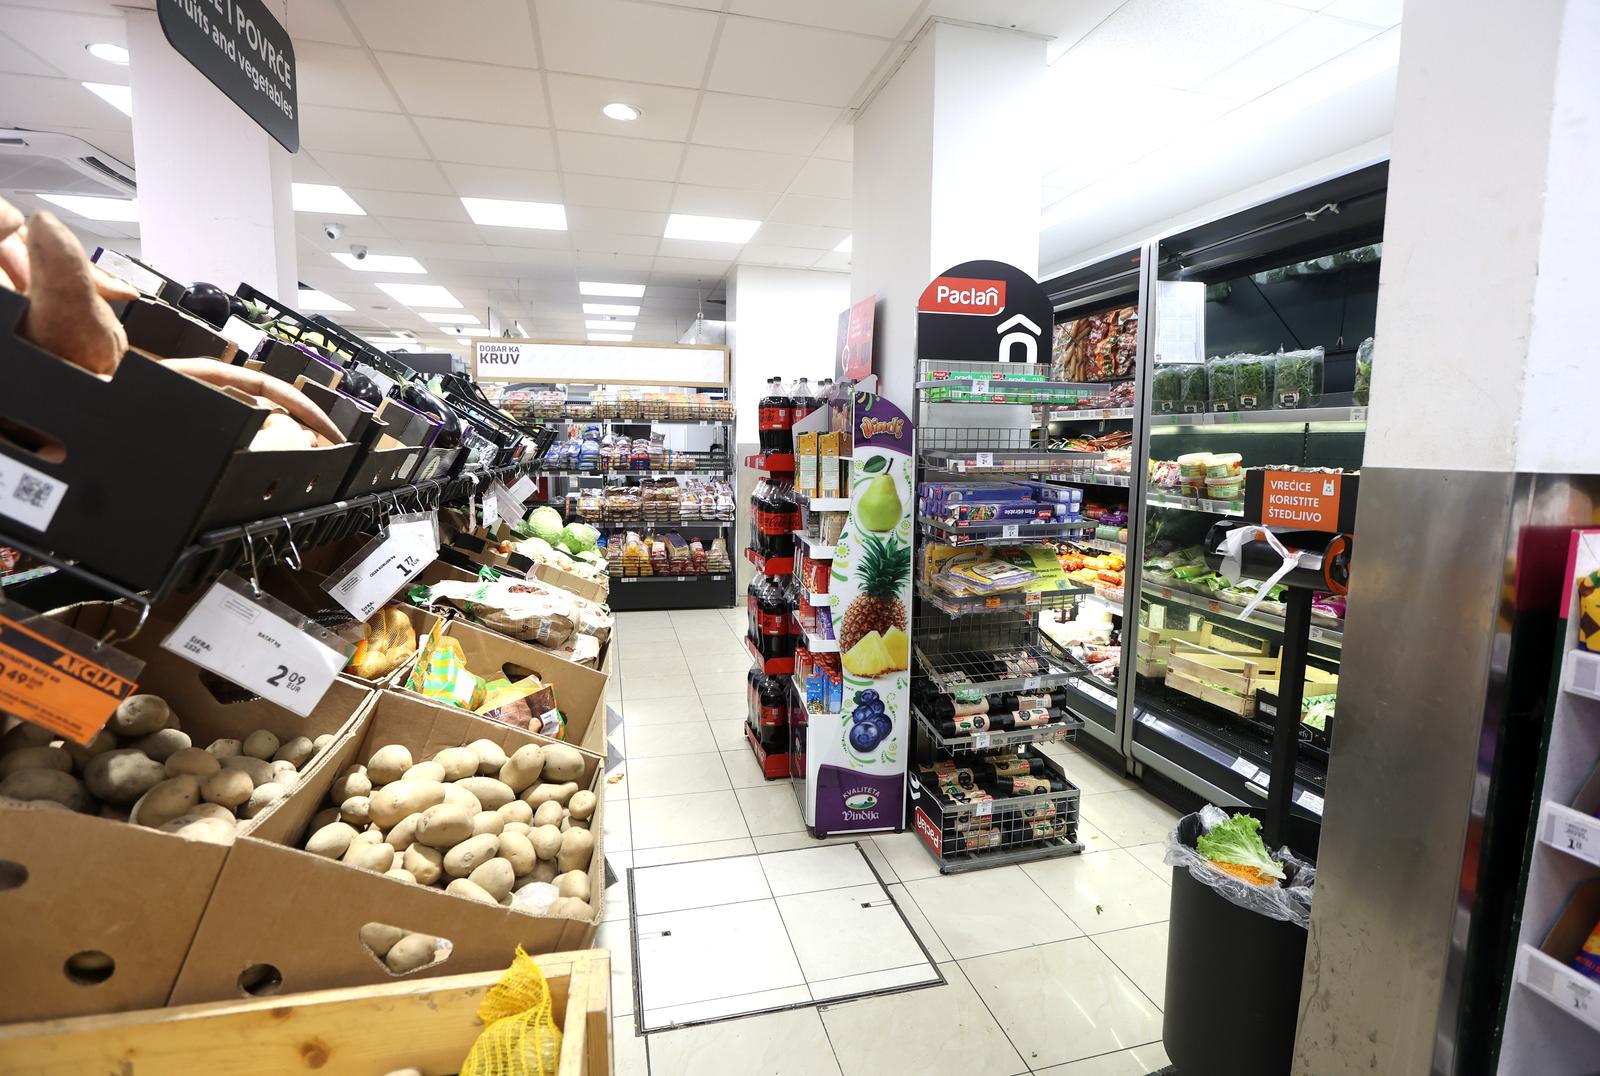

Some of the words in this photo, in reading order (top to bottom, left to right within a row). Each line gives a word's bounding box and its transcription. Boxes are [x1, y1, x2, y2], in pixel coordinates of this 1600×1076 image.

[236, 4, 292, 90] POVRĆE
[174, 0, 209, 35] uits
[212, 24, 236, 62] and
[238, 51, 293, 120] vegetables
[937, 285, 999, 306] Paclan
[480, 353, 520, 364] KRUV
[860, 416, 904, 439] Vindi
[1271, 479, 1311, 492] VREĆICE
[1269, 494, 1320, 508] KORISTITE
[1268, 506, 1322, 522] ŠTEDLJIVO
[396, 563, 412, 577] 1
[52, 654, 123, 697] AKCIJA
[266, 665, 289, 687] 2
[288, 672, 306, 686] 09
[286, 682, 301, 692] EUR
[842, 786, 880, 799] KVALITETA
[842, 810, 879, 821] Vindija
